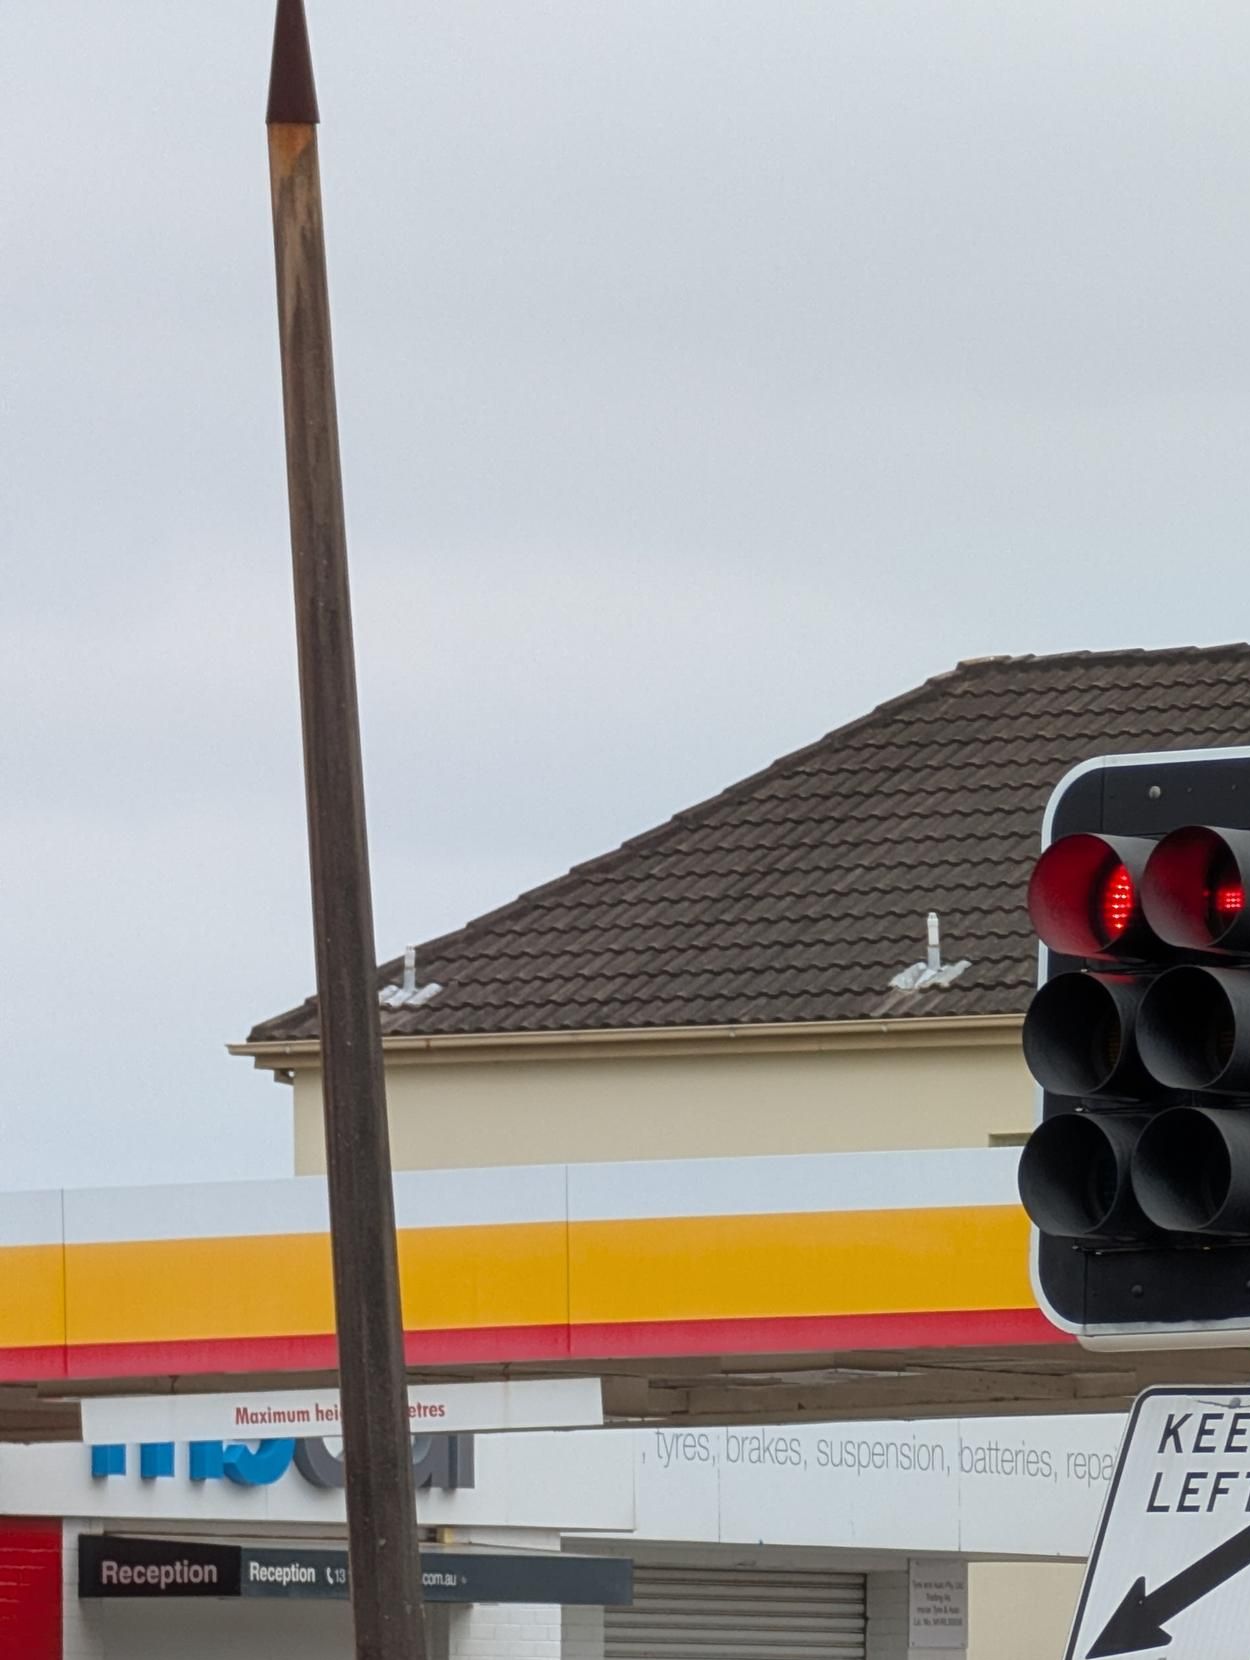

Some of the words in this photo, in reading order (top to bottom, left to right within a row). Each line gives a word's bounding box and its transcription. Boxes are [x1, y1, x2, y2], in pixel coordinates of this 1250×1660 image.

[235, 1403, 310, 1425] Maximum
[315, 1402, 342, 1423] hei
[409, 1402, 445, 1420] etres
[656, 1428, 716, 1469] tyres,
[726, 1427, 808, 1471] brakes,
[816, 1434, 951, 1477] suspension,
[959, 1437, 1058, 1483] batteries,
[101, 1560, 218, 1589] Reception
[249, 1562, 316, 1587] Reception
[423, 1573, 458, 1587] com.au
